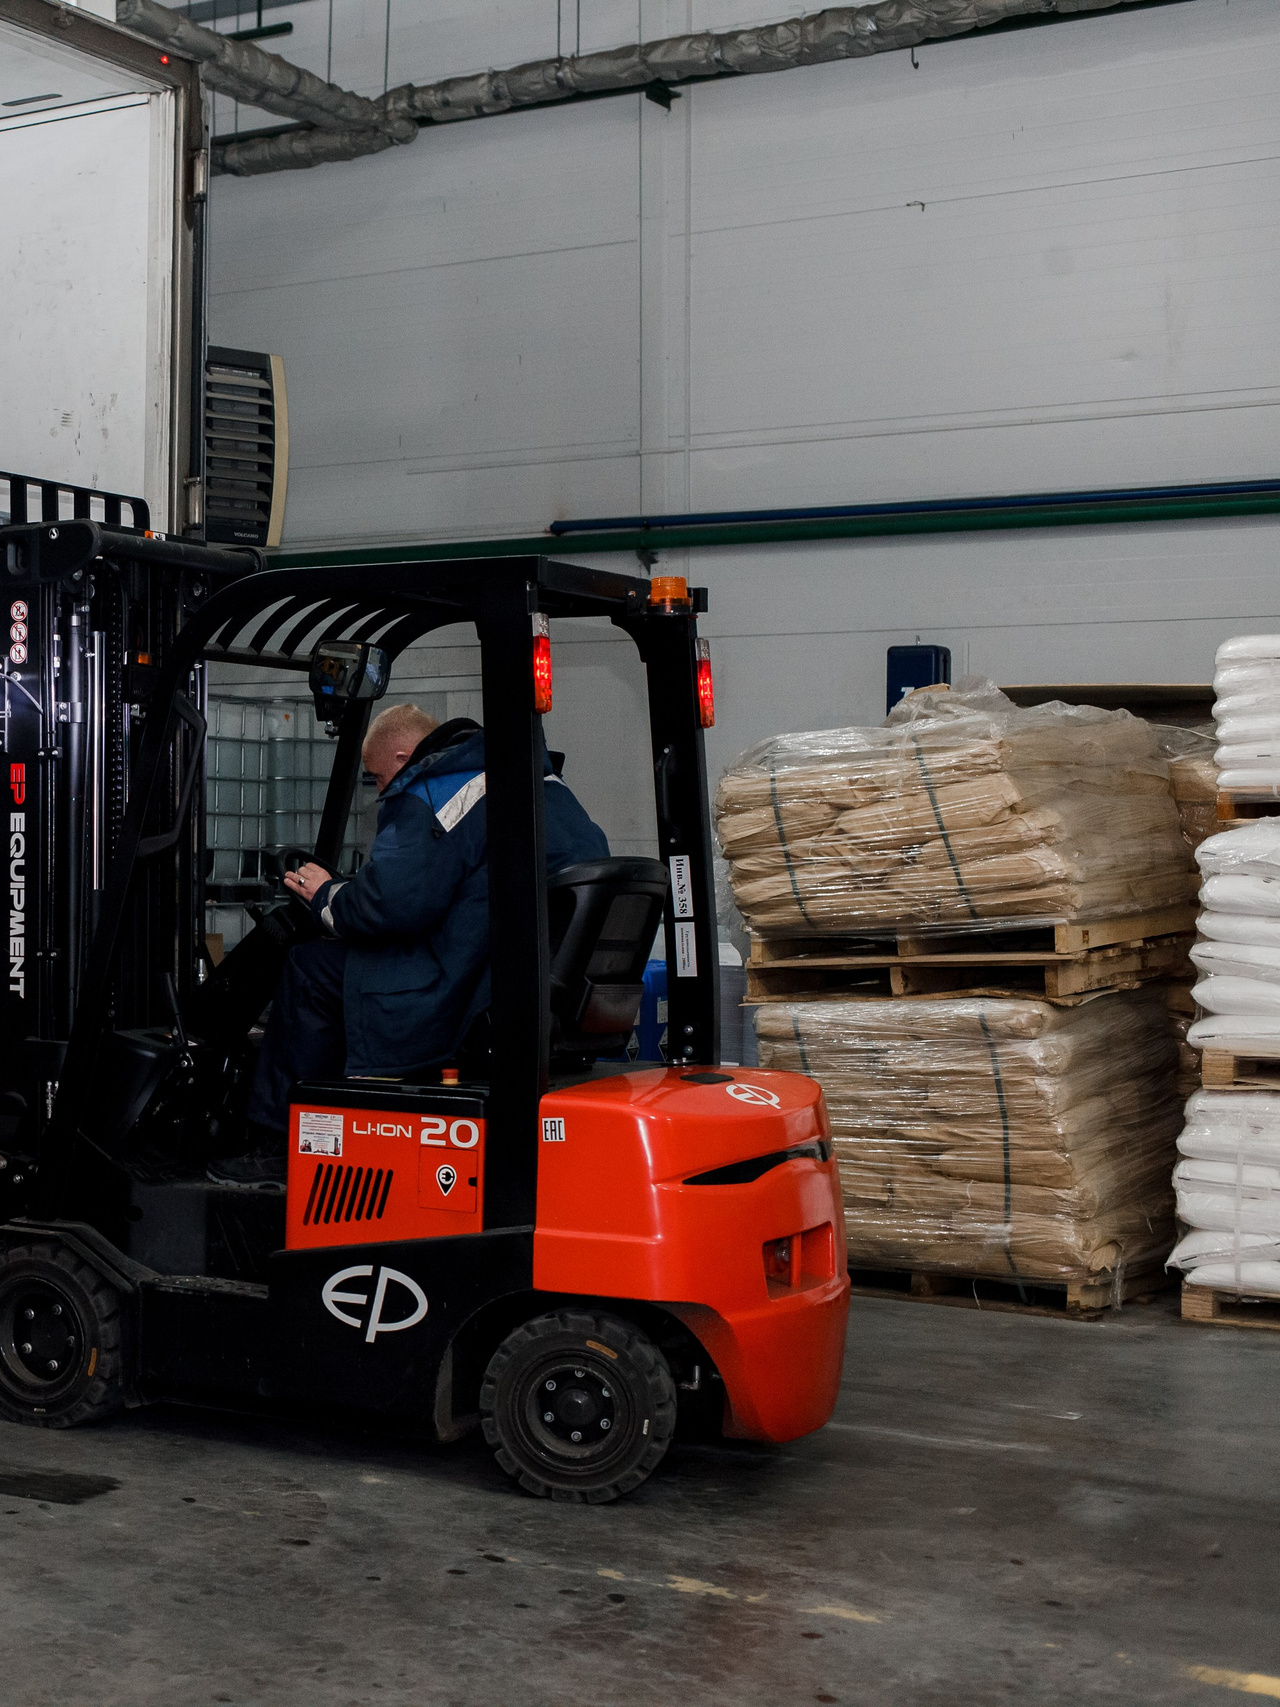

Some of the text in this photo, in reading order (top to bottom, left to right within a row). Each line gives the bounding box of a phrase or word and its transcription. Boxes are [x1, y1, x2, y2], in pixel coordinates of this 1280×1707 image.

[10, 762, 25, 999] EP EQUIPMENT
[678, 897, 688, 914] 358
[353, 1121, 412, 1138] LI-ION
[420, 1116, 479, 1148] 20
[544, 1120, 564, 1140] EAC
[322, 1265, 428, 1343] EP
